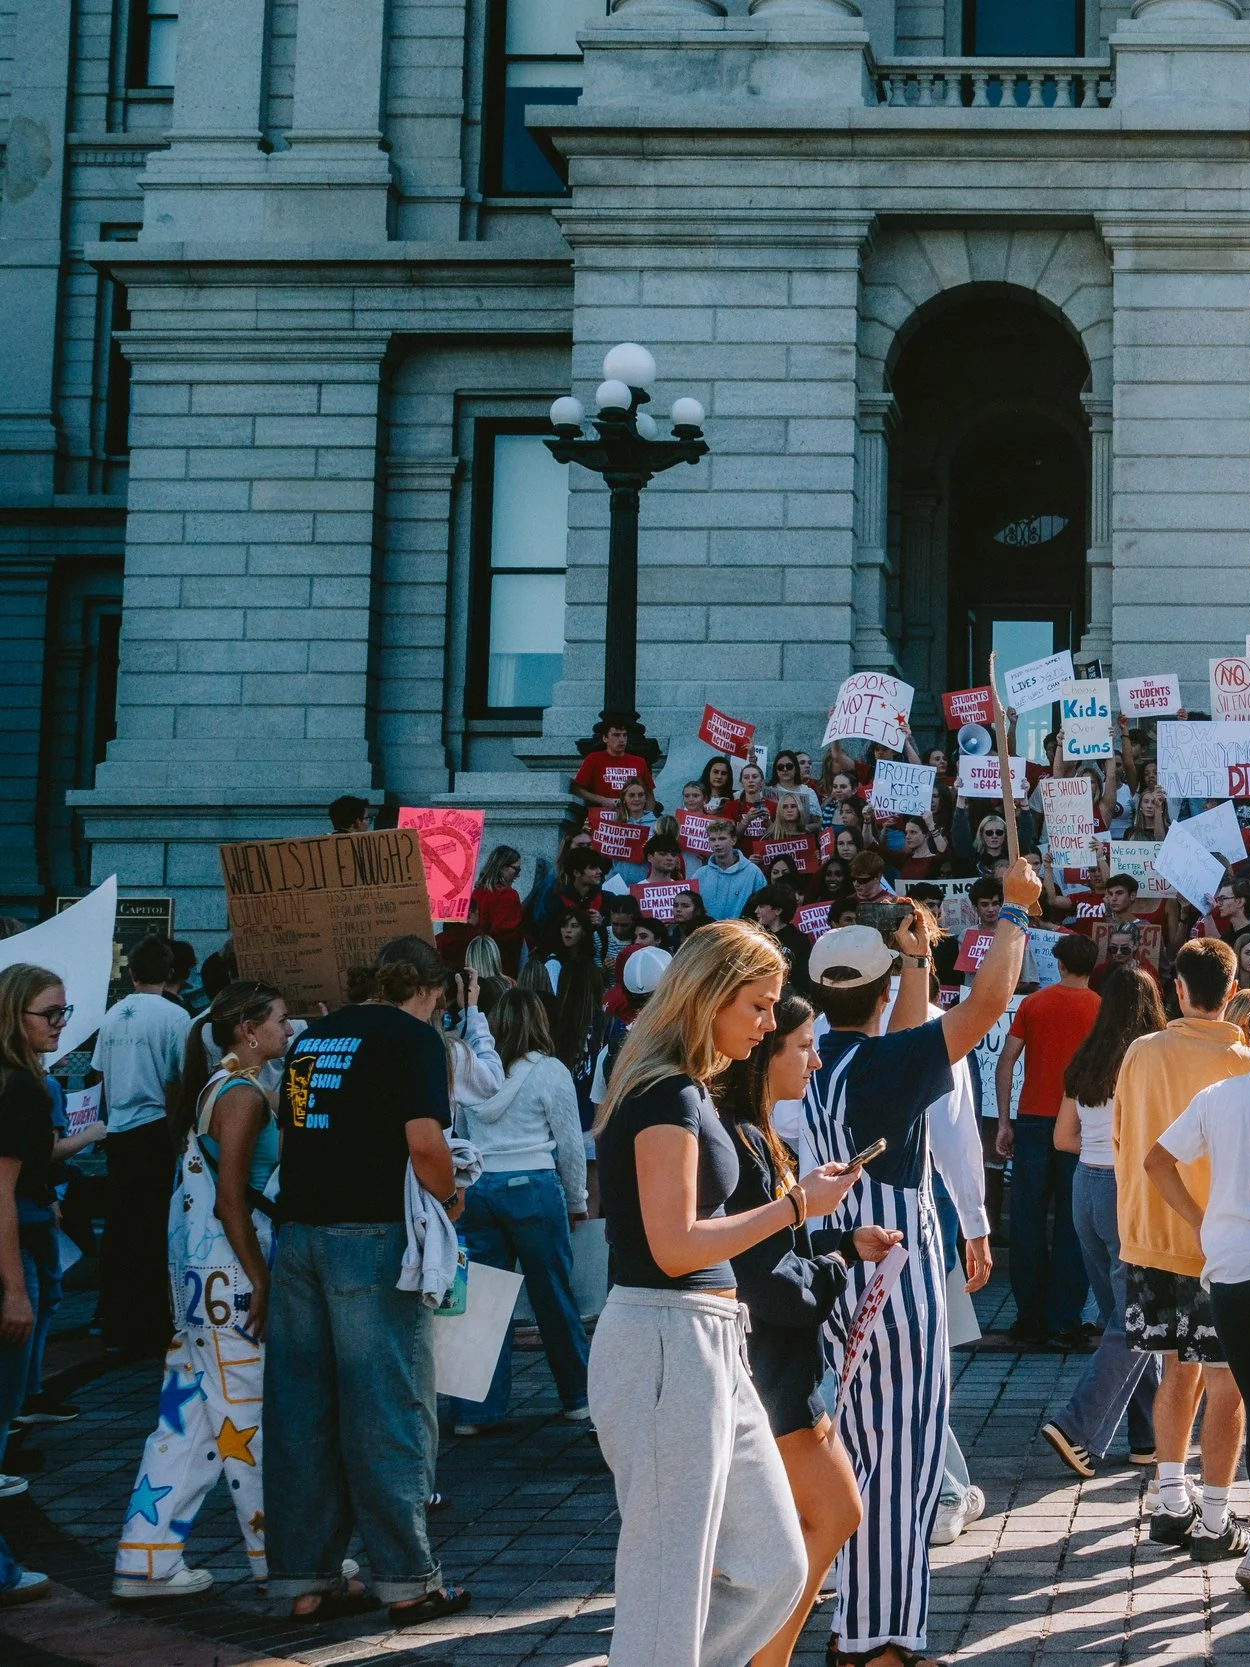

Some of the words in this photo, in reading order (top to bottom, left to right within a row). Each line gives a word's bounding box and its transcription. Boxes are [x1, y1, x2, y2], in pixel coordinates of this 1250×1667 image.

[1220, 665, 1245, 686] NO
[846, 675, 900, 697] BOOKS
[1011, 676, 1037, 694] LIVES
[1062, 684, 1097, 696] Choose
[952, 692, 987, 705] STUDENTS
[1129, 686, 1171, 699] STUDENTS
[838, 694, 883, 716] NOT
[951, 705, 977, 715] DEMAND
[1063, 697, 1108, 718] Kids
[1139, 697, 1168, 709] 644-33
[713, 714, 745, 735] STUDENTS
[961, 713, 985, 723] ACTION
[708, 720, 731, 739] DEMAND
[829, 717, 903, 746] BULLETS
[1071, 724, 1094, 735] Over
[1161, 724, 1217, 748] HOW
[713, 735, 735, 751] ACTION
[1068, 739, 1110, 755] Guns
[1161, 742, 1233, 769] MANY
[606, 768, 637, 776] STUDENTS
[878, 762, 936, 785] PROTECT
[971, 768, 1015, 779] STUDES
[891, 783, 919, 796] KIDS
[980, 779, 1002, 789] 644-
[1041, 782, 1056, 798] WE
[1058, 780, 1088, 797] SHOULD
[1158, 771, 1203, 796] HAVE
[1203, 771, 1224, 796] TO
[874, 797, 897, 809] NOT
[898, 799, 926, 815] GUNS
[686, 816, 709, 828] STUDE
[1046, 814, 1054, 824] TO
[1056, 814, 1067, 824] GO
[1070, 814, 1084, 824] TO
[401, 810, 436, 831] GUN
[443, 810, 481, 846] CONTROL
[600, 825, 640, 839] STUDENTS
[745, 828, 766, 836] CTION
[1078, 824, 1094, 834] NOT
[594, 831, 625, 846] DEMAND
[687, 838, 711, 850] ACTIO
[1049, 836, 1059, 848] TO
[1061, 836, 1084, 849] COME
[601, 845, 631, 857] ACTION
[766, 841, 808, 854] STUDENTS
[1112, 847, 1124, 855] WE
[1124, 846, 1136, 855] GO
[1138, 846, 1149, 855] TO
[222, 845, 272, 895] WHEN
[270, 842, 305, 890] IS
[300, 839, 330, 890] IT
[335, 833, 413, 887] ENOUGH?
[1051, 851, 1071, 865] HOME
[645, 885, 689, 897] STUDENTS
[953, 883, 971, 894] NO
[1148, 878, 1171, 891] END
[120, 904, 165, 914] CAPITOL
[431, 898, 468, 918] OW!!
[653, 909, 673, 919] ACTI
[802, 907, 831, 922] STUDE
[800, 919, 829, 933] DEMAN
[1096, 928, 1157, 948] PECT
[969, 946, 987, 957] DEM
[294, 1038, 362, 1055] EVERGREEN
[315, 1055, 352, 1070] GIRLS
[310, 1074, 341, 1089] SWIM
[308, 1093, 316, 1108] &
[68, 1105, 97, 1126] STUDENTS
[305, 1114, 329, 1129] DIV
[184, 1270, 231, 1327] 26
